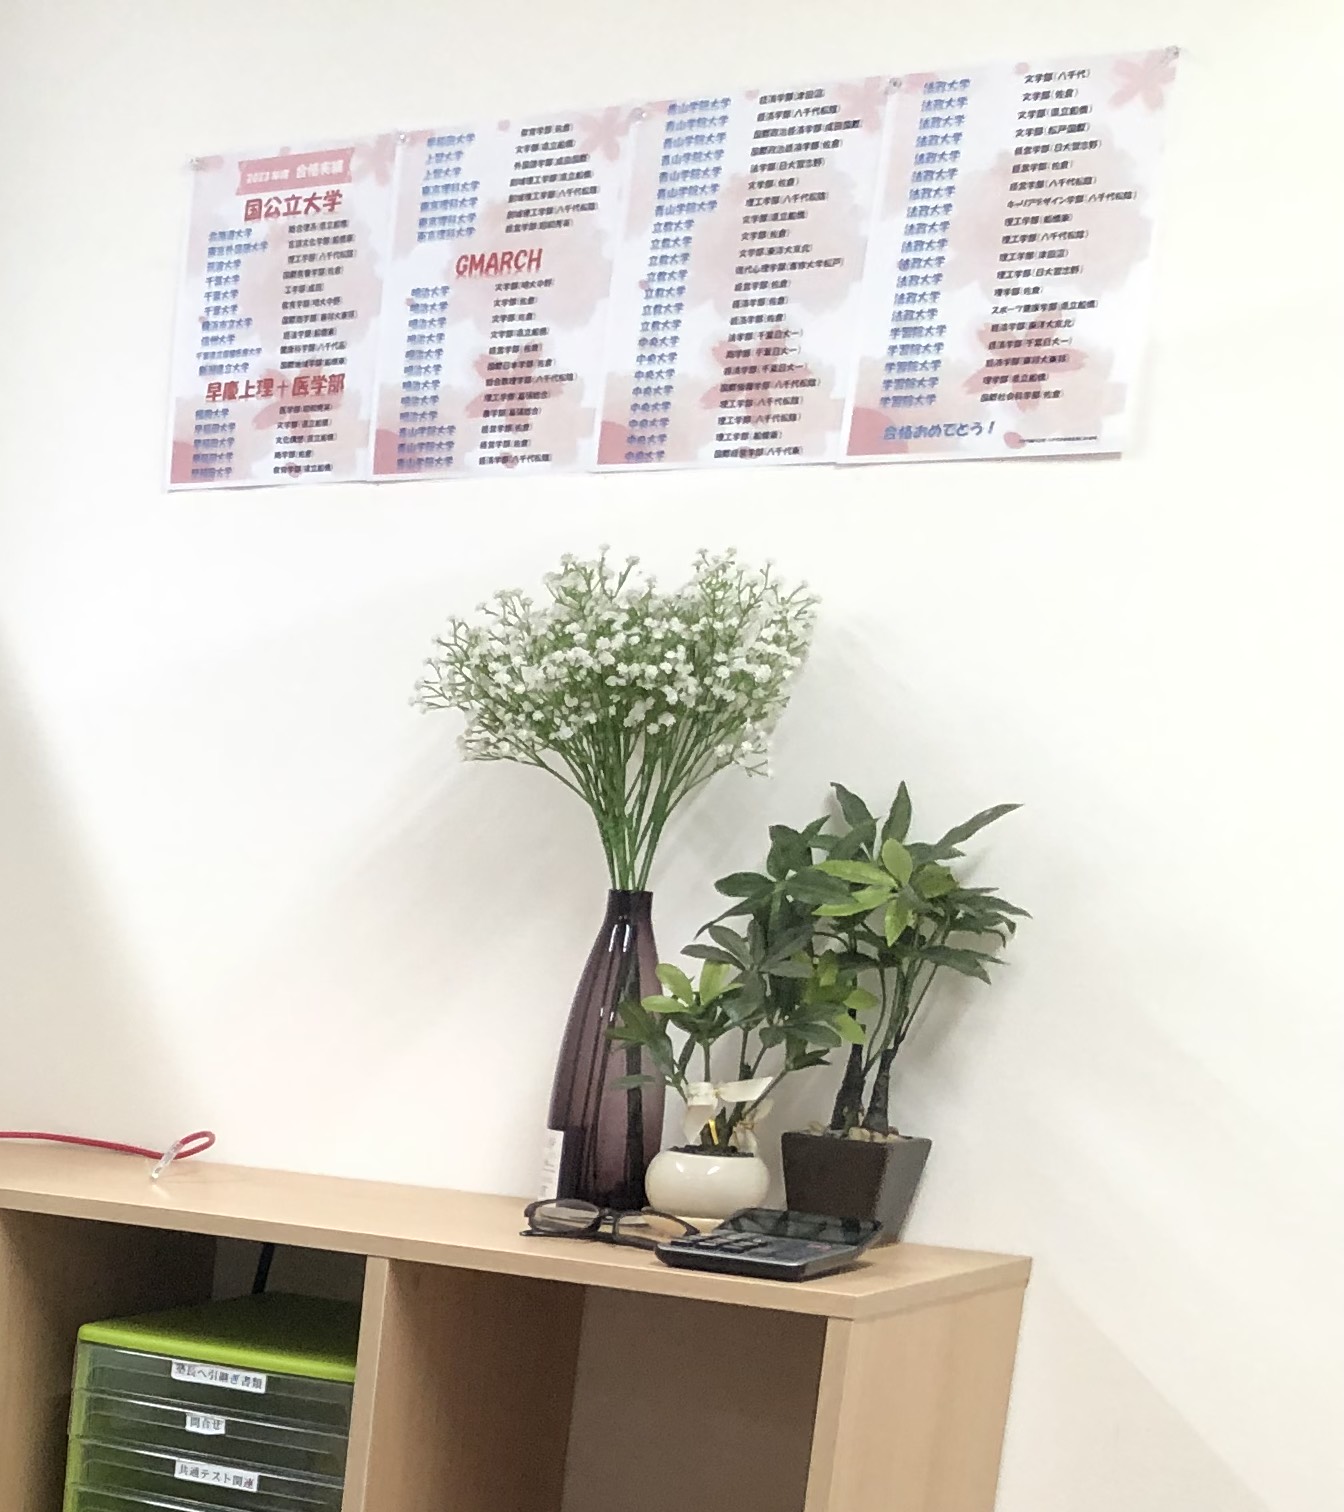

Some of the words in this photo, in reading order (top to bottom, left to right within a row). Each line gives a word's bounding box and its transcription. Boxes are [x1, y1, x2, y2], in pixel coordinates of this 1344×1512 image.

[244, 189, 343, 222] 国公立大学
[455, 248, 543, 277] GMARCH
